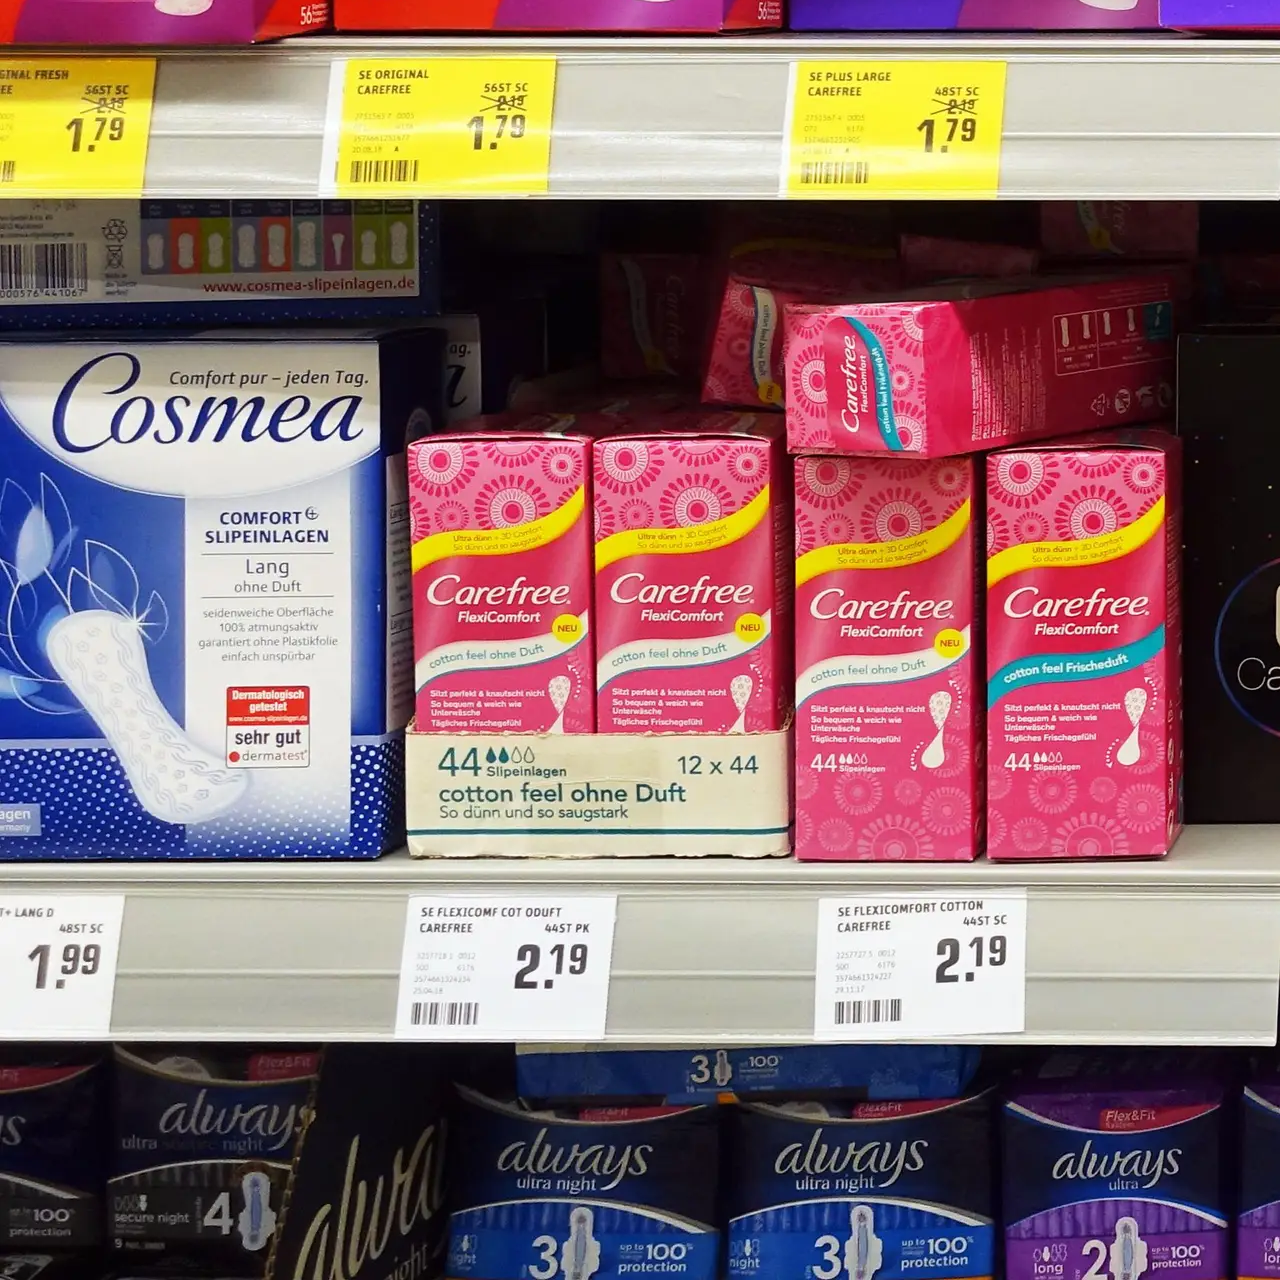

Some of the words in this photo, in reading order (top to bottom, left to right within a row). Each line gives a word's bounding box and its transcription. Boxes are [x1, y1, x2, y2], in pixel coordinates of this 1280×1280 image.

[359, 69, 371, 79] SE
[375, 69, 429, 79] ORIGINAL
[357, 84, 411, 94] CAREFREE
[484, 83, 510, 92] 56ST
[514, 83, 528, 92] SC
[467, 114, 526, 151] 1.79
[203, 277, 415, 293] www.cosmea-slipeinlagen.de
[170, 371, 235, 388] Comfort
[240, 373, 267, 387] pur
[285, 370, 329, 388] jeden
[335, 370, 369, 388] Tag.
[52, 352, 364, 454] Cosmea
[219, 511, 301, 526] COMFORT
[205, 529, 329, 544] SLIPEINLAGEN
[426, 574, 571, 609] Carefree
[458, 610, 540, 625] FlexiComfort
[438, 748, 481, 776] 44
[678, 756, 702, 774] 12
[709, 760, 720, 774] x
[729, 756, 758, 774] 44
[439, 786, 514, 804] cotton
[521, 783, 556, 803] feel
[562, 784, 628, 803] ohne
[636, 783, 686, 803] Duft
[514, 944, 588, 989] 2.19
[497, 1128, 653, 1198] always
